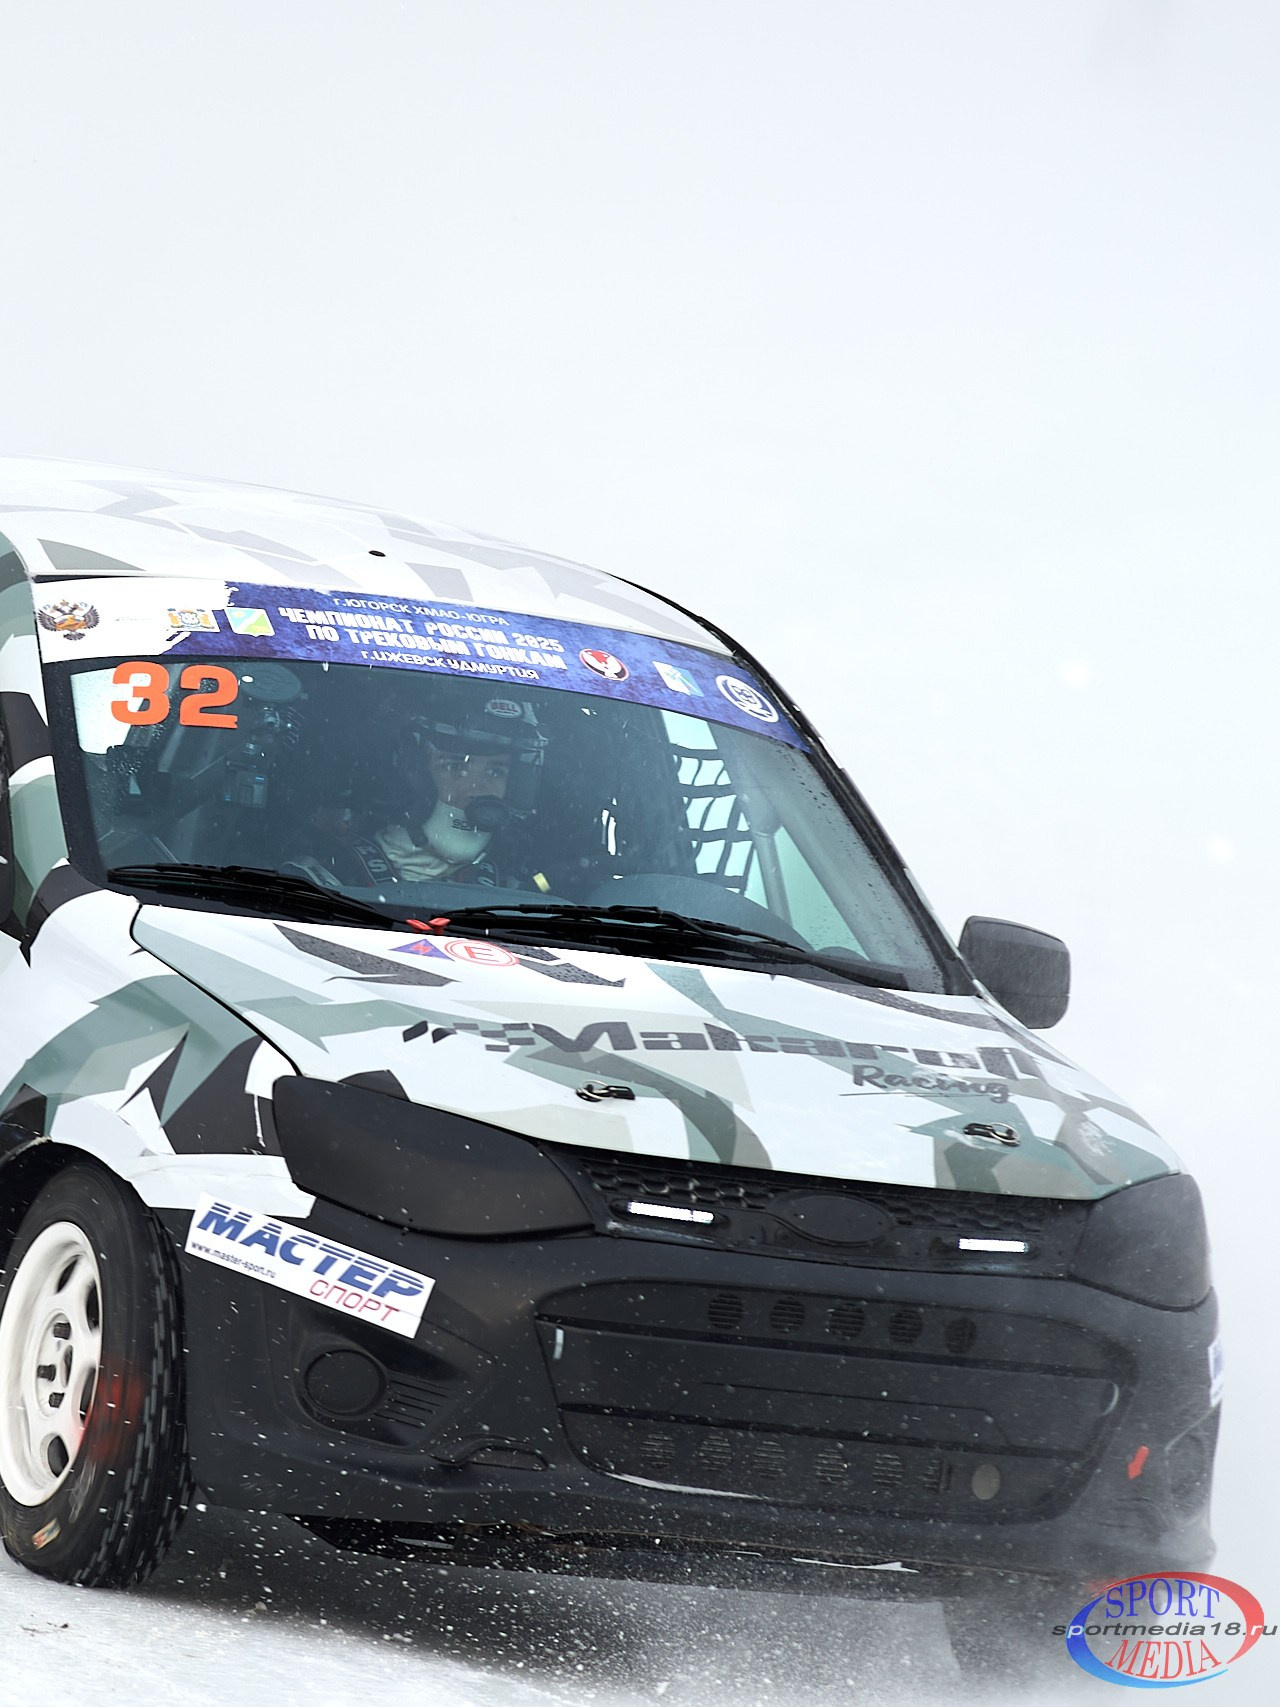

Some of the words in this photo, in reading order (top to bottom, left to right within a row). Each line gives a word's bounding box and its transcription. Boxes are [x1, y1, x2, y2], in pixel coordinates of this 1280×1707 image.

[278, 606, 414, 634] ЧЕМПИОНАТ
[424, 621, 510, 645] РОССИИ
[511, 632, 565, 654] 2025
[333, 598, 412, 615] г.ЮГОРСК
[413, 606, 511, 627] ХМАО-ЮГРА
[305, 624, 341, 642] ПО
[344, 628, 472, 656] ТРЕКОВЫМ
[476, 642, 569, 670] ГОНКАМ
[448, 657, 540, 680] УДМУРТИЯ
[111, 661, 239, 729] 32
[851, 1063, 1010, 1104] Racing
[190, 1240, 277, 1279] www.master-sport.ru
[196, 1202, 425, 1298] МАСТЕР
[308, 1279, 400, 1322] СПОРТ
